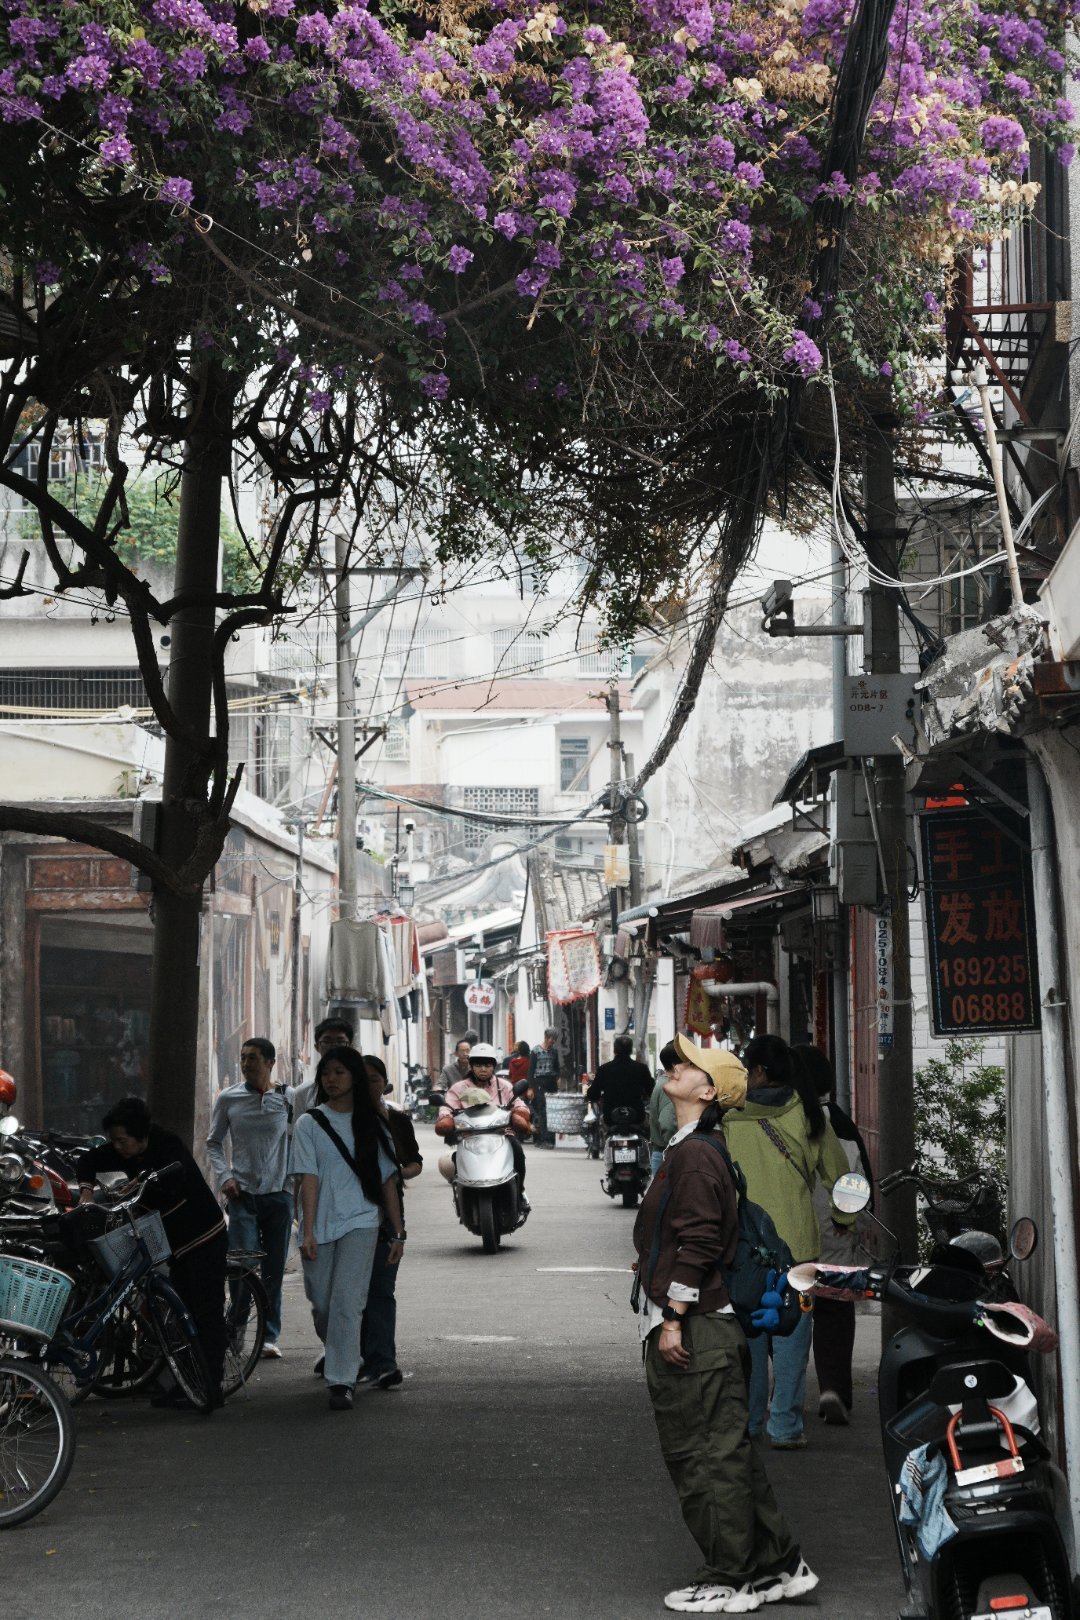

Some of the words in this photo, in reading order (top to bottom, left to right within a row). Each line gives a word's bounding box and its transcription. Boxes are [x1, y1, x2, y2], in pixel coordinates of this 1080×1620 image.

[933, 830, 1020, 880] 手工
[939, 890, 1025, 946] 发放
[939, 954, 1027, 988] 189235
[951, 992, 1025, 1025] 06888
